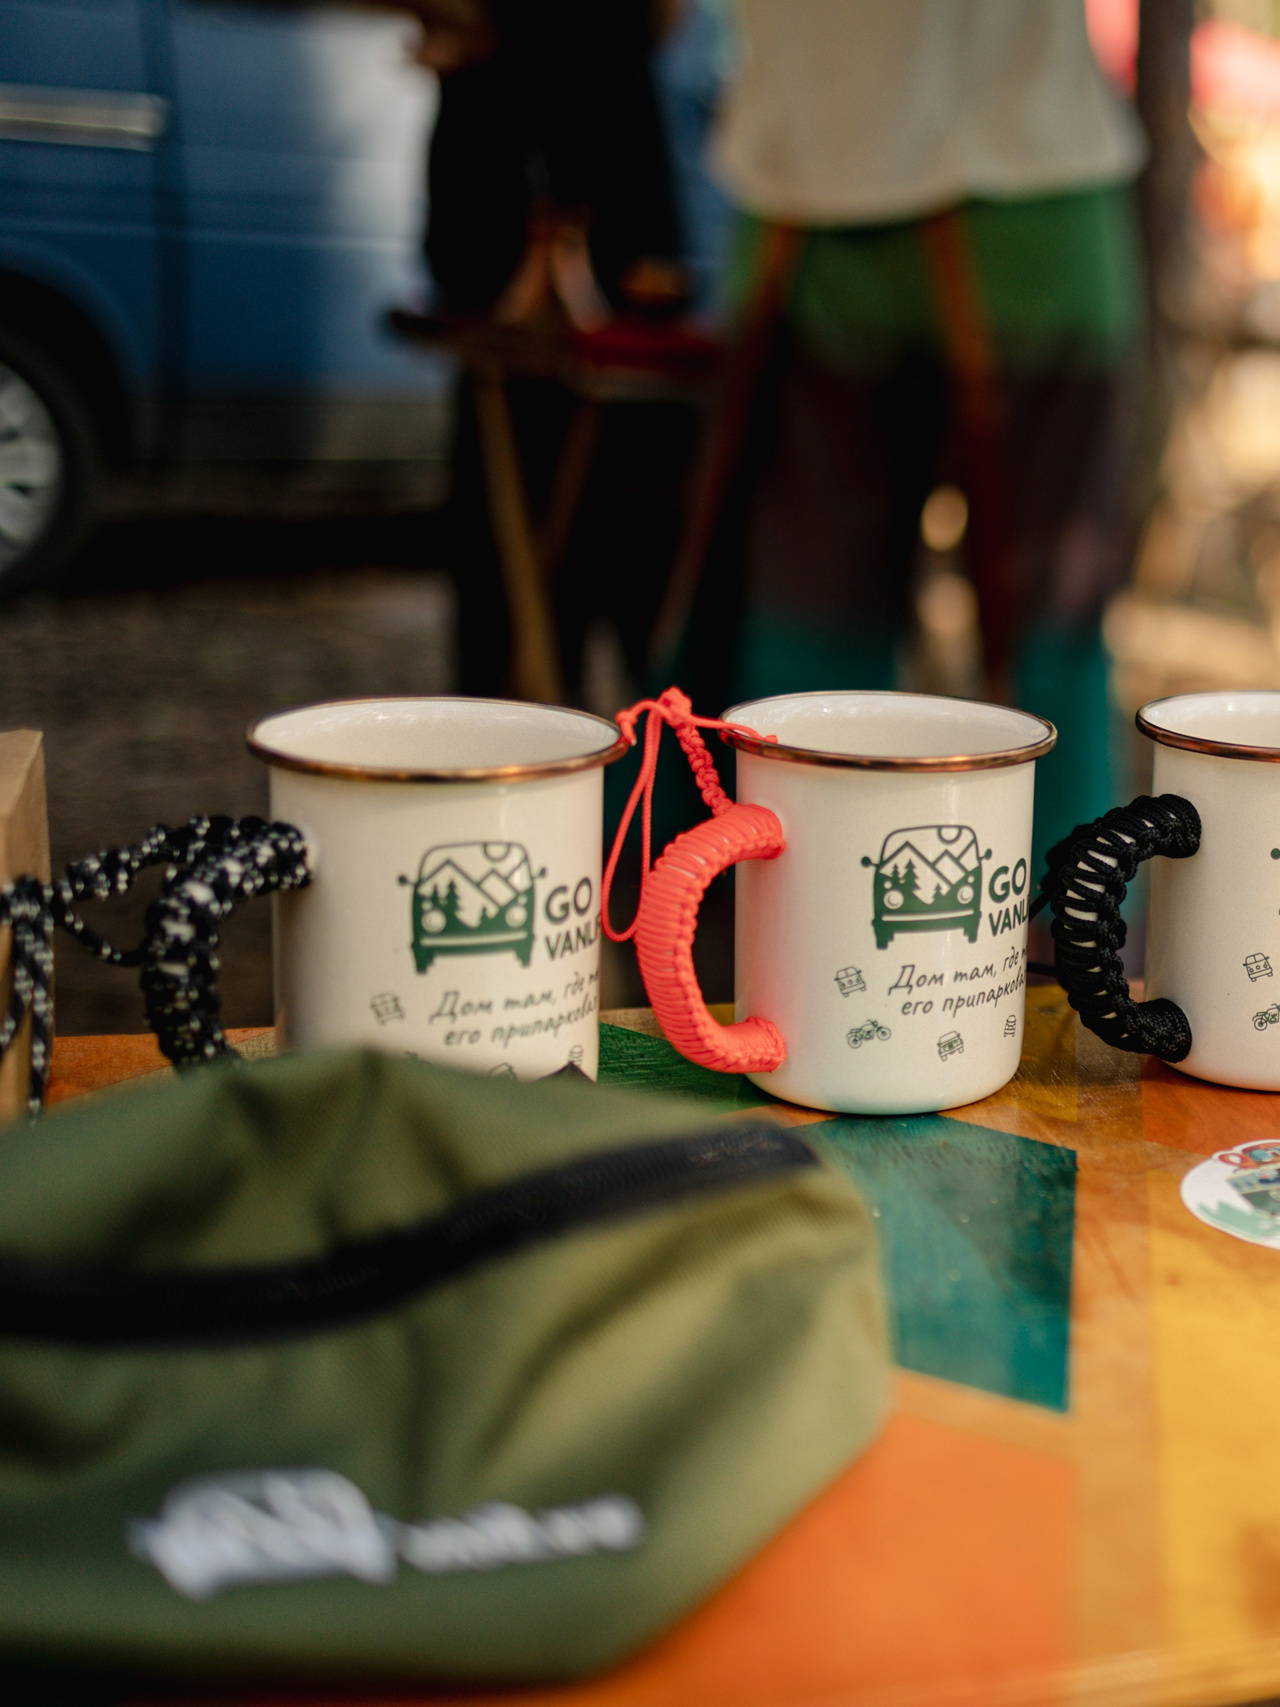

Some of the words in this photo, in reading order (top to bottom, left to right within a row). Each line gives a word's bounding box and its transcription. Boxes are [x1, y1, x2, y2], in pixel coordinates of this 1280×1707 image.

[545, 876, 592, 925] GO
[988, 857, 1027, 904] GO
[887, 964, 944, 996] Дом
[953, 963, 997, 979] там,
[1002, 946, 1020, 972] где
[428, 990, 493, 1024] Дом
[901, 1000, 934, 1016] его
[443, 1028, 481, 1046] его
